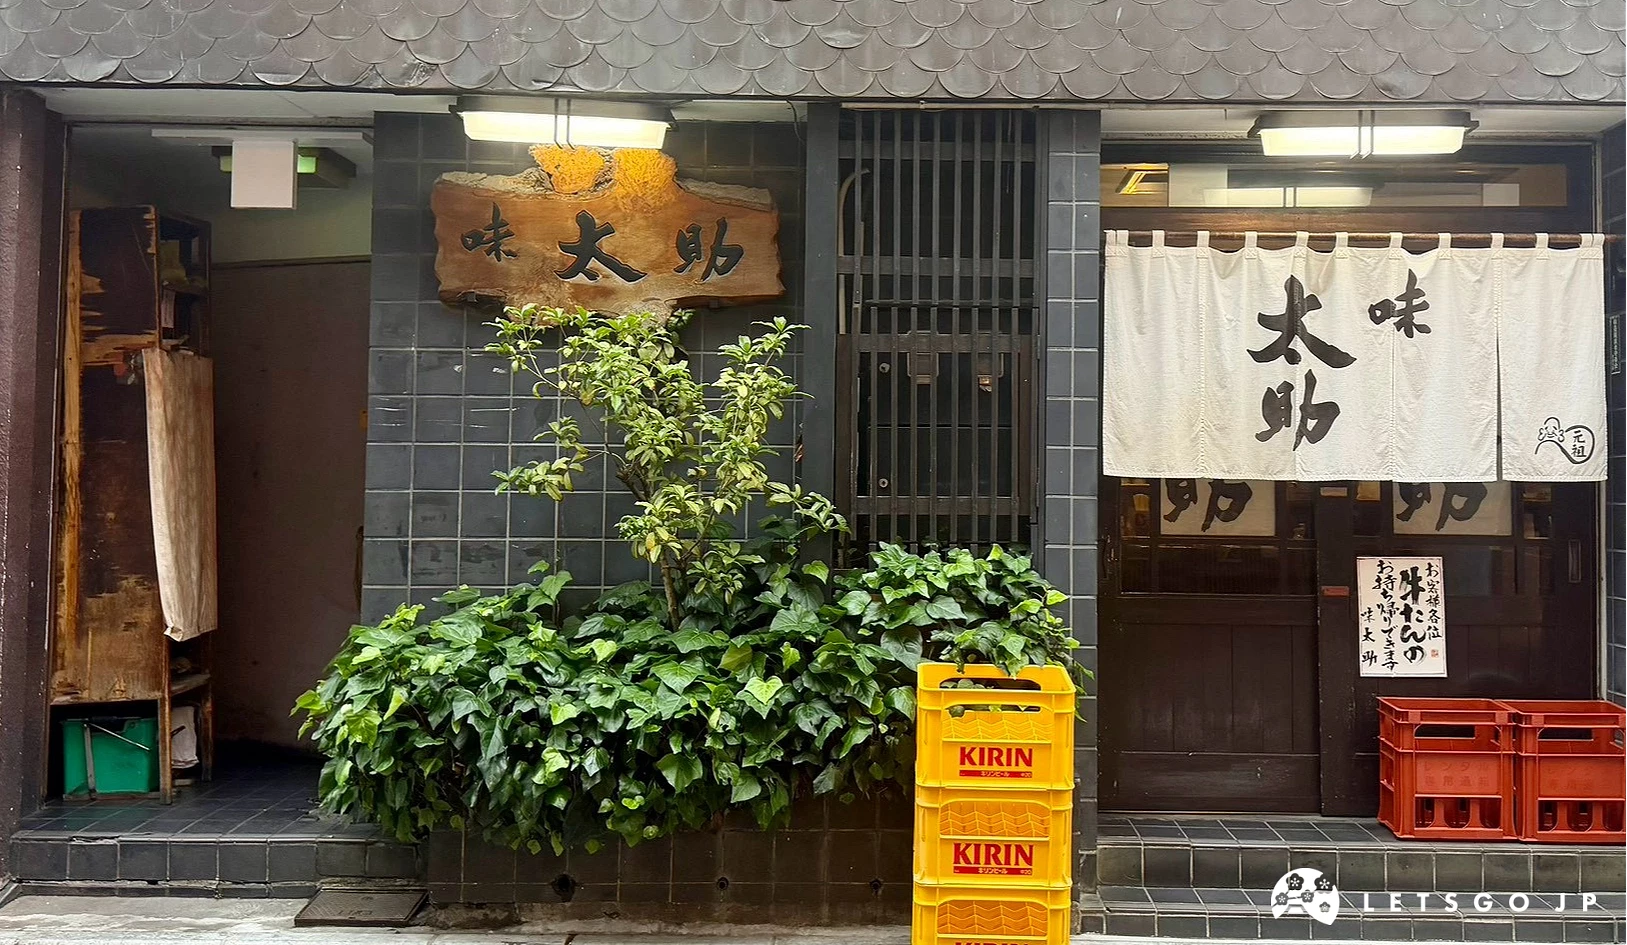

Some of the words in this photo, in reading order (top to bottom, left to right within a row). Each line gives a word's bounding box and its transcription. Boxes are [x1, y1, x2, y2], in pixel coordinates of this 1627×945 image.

[1367, 267, 1432, 339] 味
[1246, 274, 1357, 452] 太助
[1571, 430, 1587, 457] 元祖
[1372, 559, 1399, 671] お持ち帰りできます
[1399, 565, 1427, 665] 牛たんの
[1425, 561, 1442, 640] お客様各位
[1360, 607, 1378, 668] 味太助
[959, 746, 1034, 767] KIRIN
[953, 842, 1035, 867] KIRIN
